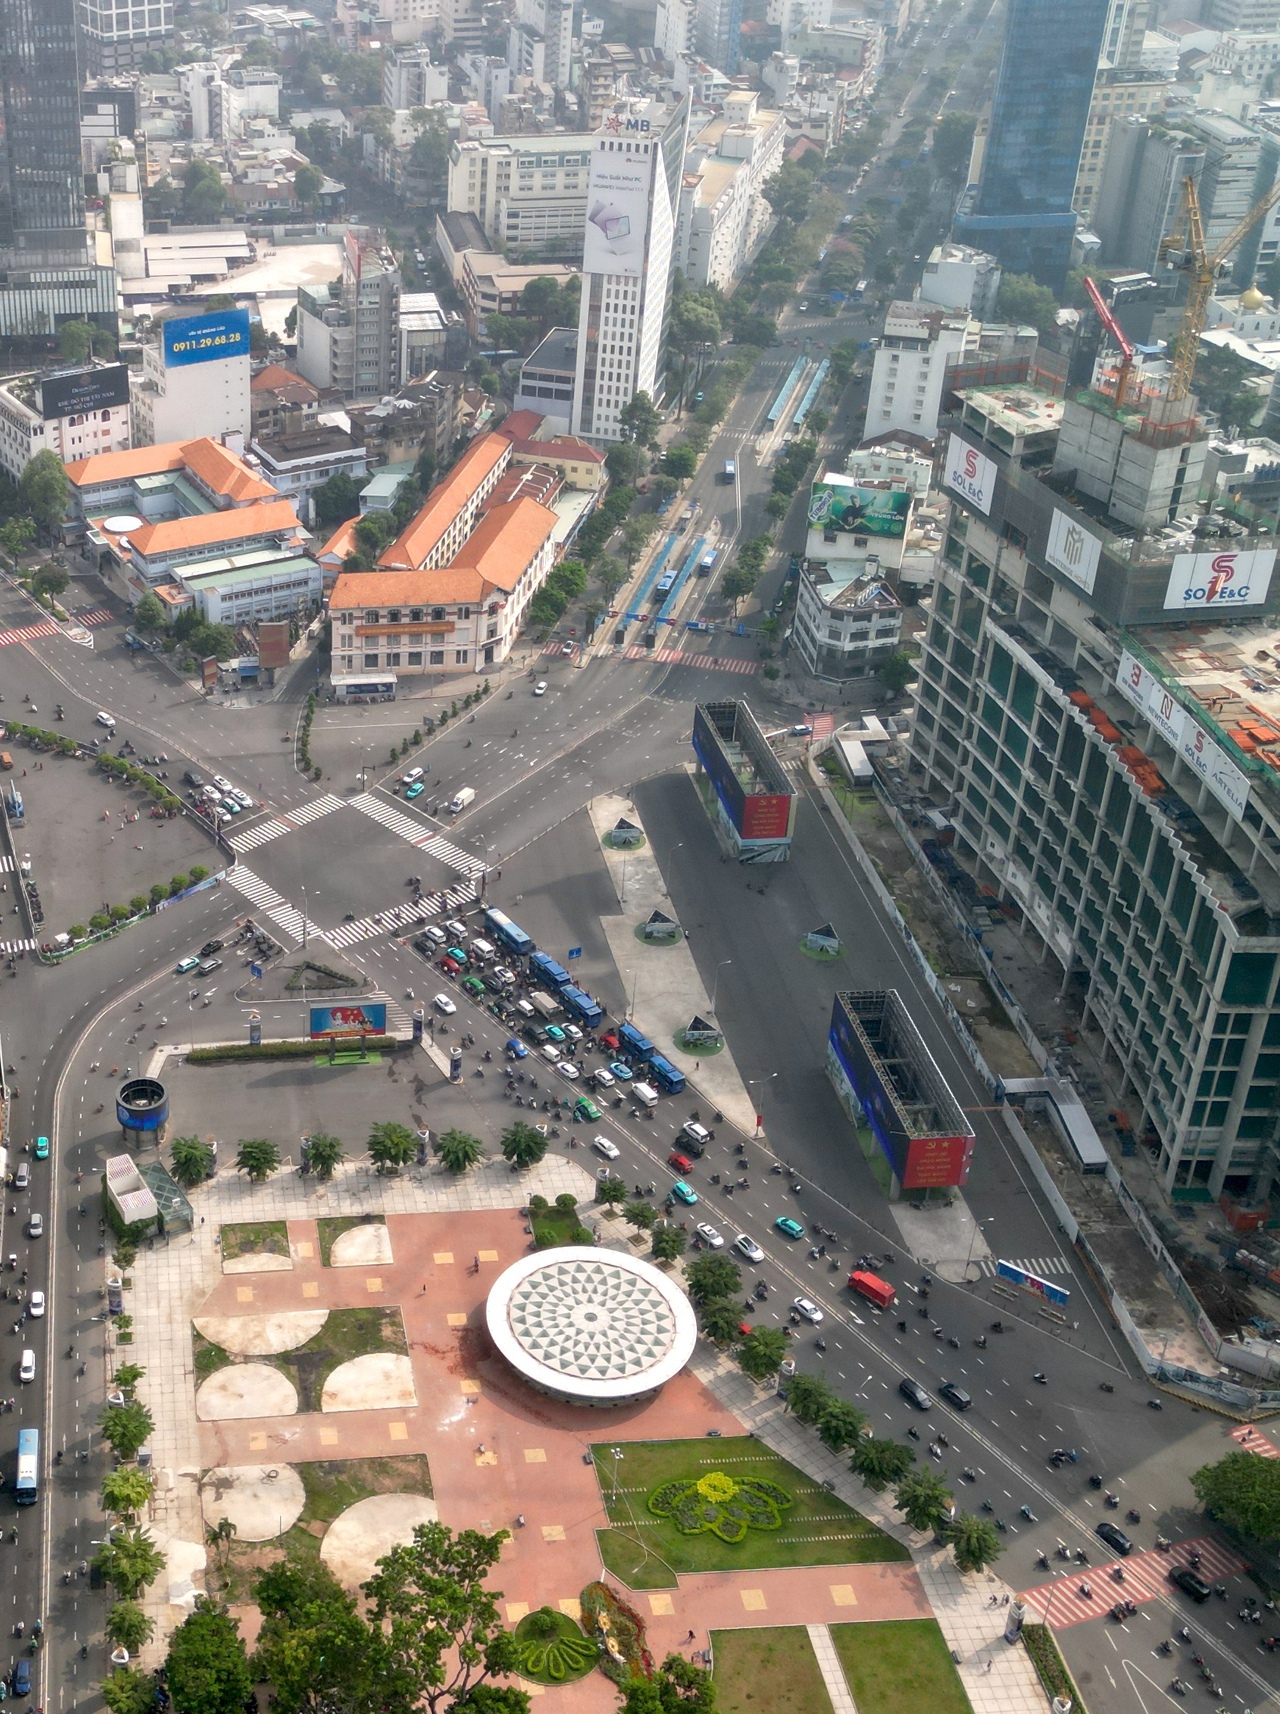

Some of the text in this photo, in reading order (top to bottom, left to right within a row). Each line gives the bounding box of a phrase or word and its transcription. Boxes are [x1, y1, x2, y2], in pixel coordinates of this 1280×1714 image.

[625, 119, 651, 132] MB
[173, 332, 241, 352] 0911.29.68.28
[952, 470, 967, 491] SOL
[967, 483, 984, 502] E&C
[810, 489, 834, 521] TUBORG
[1219, 585, 1250, 599] E&C
[1148, 704, 1179, 742] NEWTECONS
[1184, 743, 1207, 774] SOL E&C
[1212, 772, 1243, 811] ARTELIA
